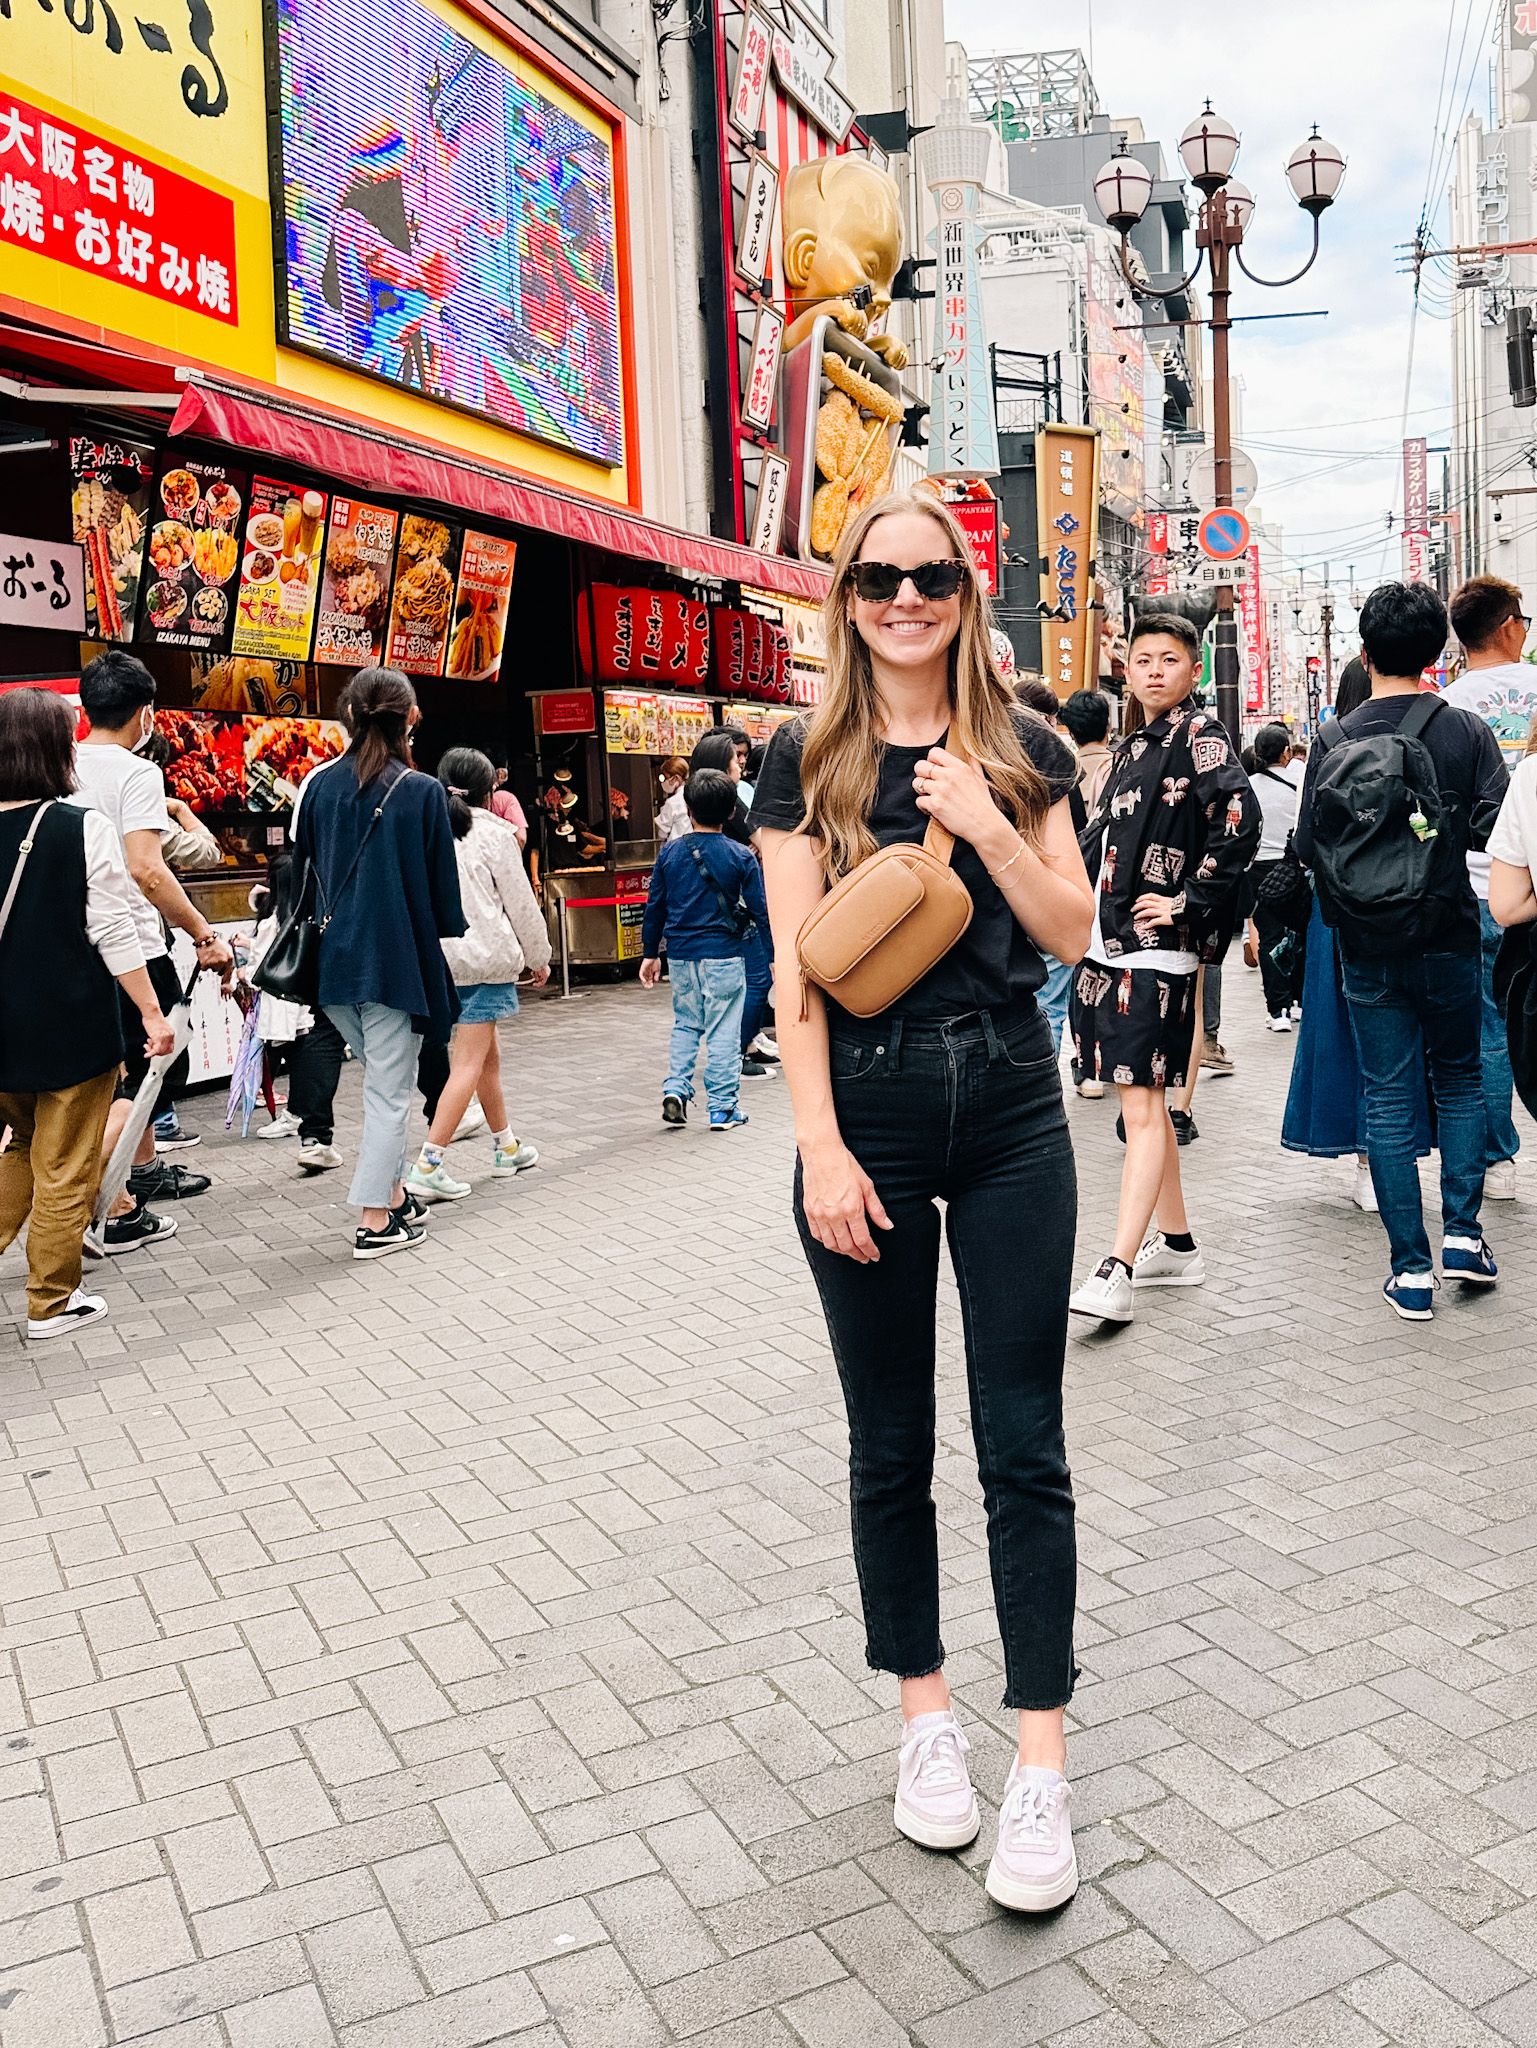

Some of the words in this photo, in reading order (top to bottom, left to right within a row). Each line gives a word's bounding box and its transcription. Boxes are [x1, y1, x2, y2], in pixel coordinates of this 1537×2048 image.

[0, 106, 155, 217] 大阪名物
[760, 326, 778, 416] アスパラ
[1059, 449, 1074, 497] 道頓堀
[1408, 442, 1424, 532] カラオケパセラ
[241, 584, 260, 595] OSAKA
[264, 588, 276, 598] SET
[1203, 567, 1246, 580] 自動車
[156, 631, 188, 645] IZAKAYA
[189, 635, 211, 648] MENU
[1059, 636, 1073, 682] 総本店
